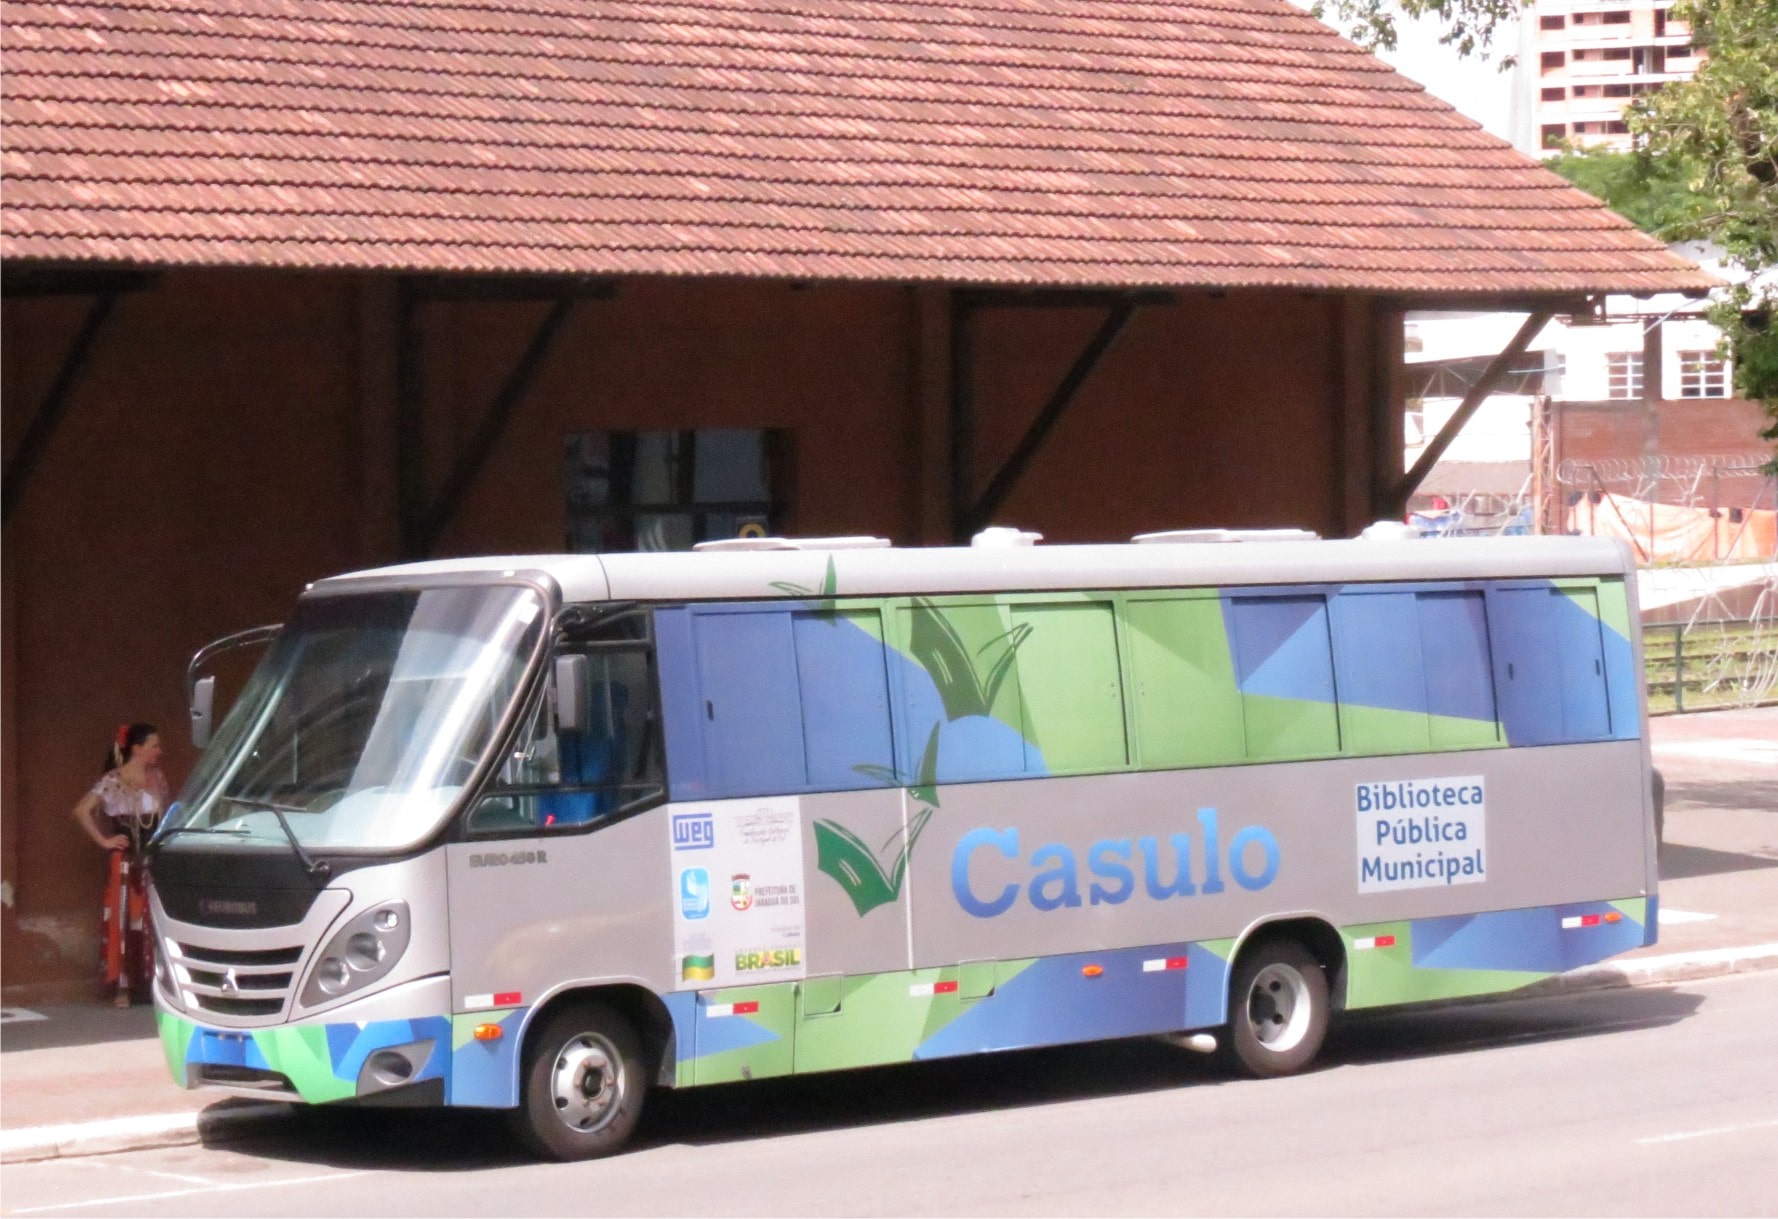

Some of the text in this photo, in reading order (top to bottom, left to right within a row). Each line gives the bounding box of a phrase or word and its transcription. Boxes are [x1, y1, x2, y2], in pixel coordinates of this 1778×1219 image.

[1357, 782, 1483, 812] Biblioteca
[1376, 816, 1467, 846] Pública
[951, 807, 1281, 918] Casulo
[1362, 848, 1484, 885] Municipal
[781, 896, 789, 905] DO
[789, 884, 796, 894] DE
[735, 949, 800, 971] BRASIL
